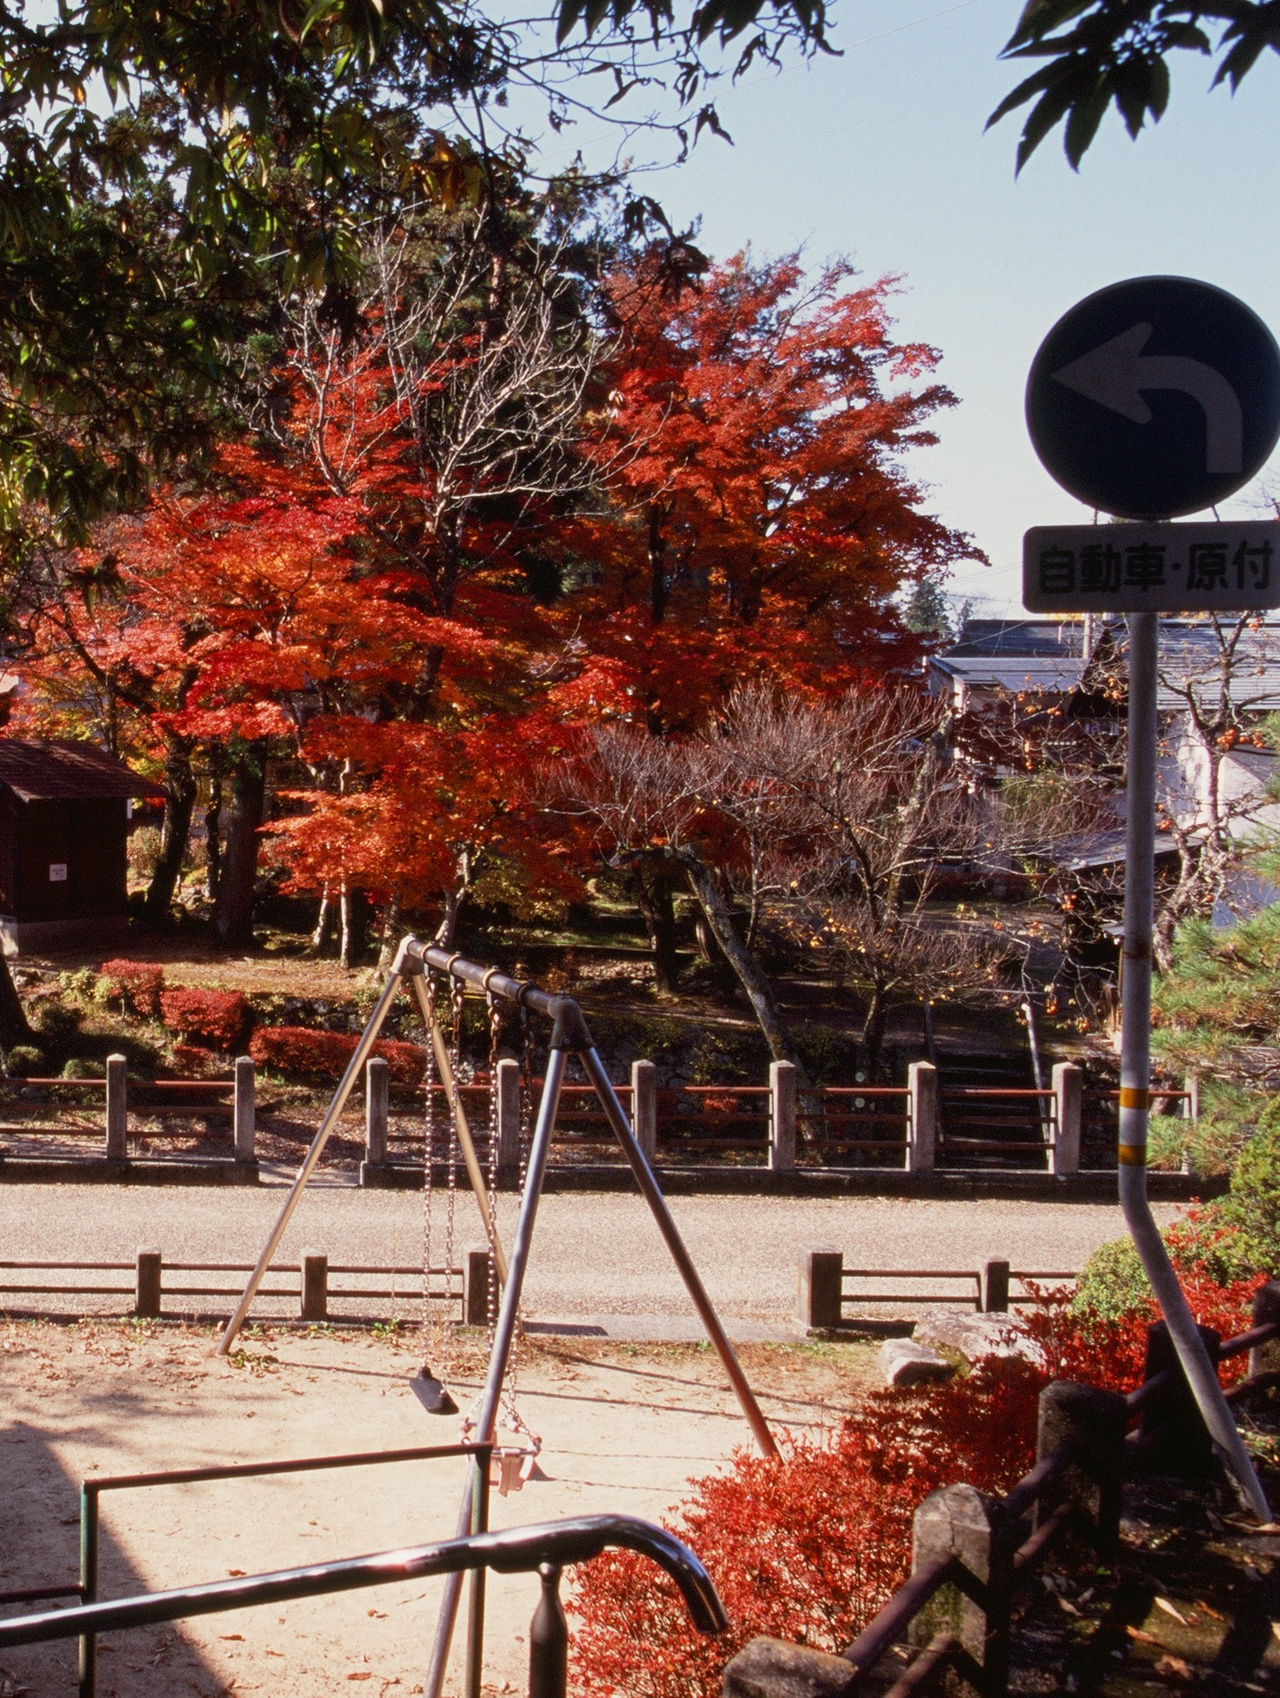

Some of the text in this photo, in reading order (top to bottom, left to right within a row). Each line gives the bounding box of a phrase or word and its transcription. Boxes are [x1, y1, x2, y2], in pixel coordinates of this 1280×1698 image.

[1039, 540, 1273, 594] 自動車・原付
